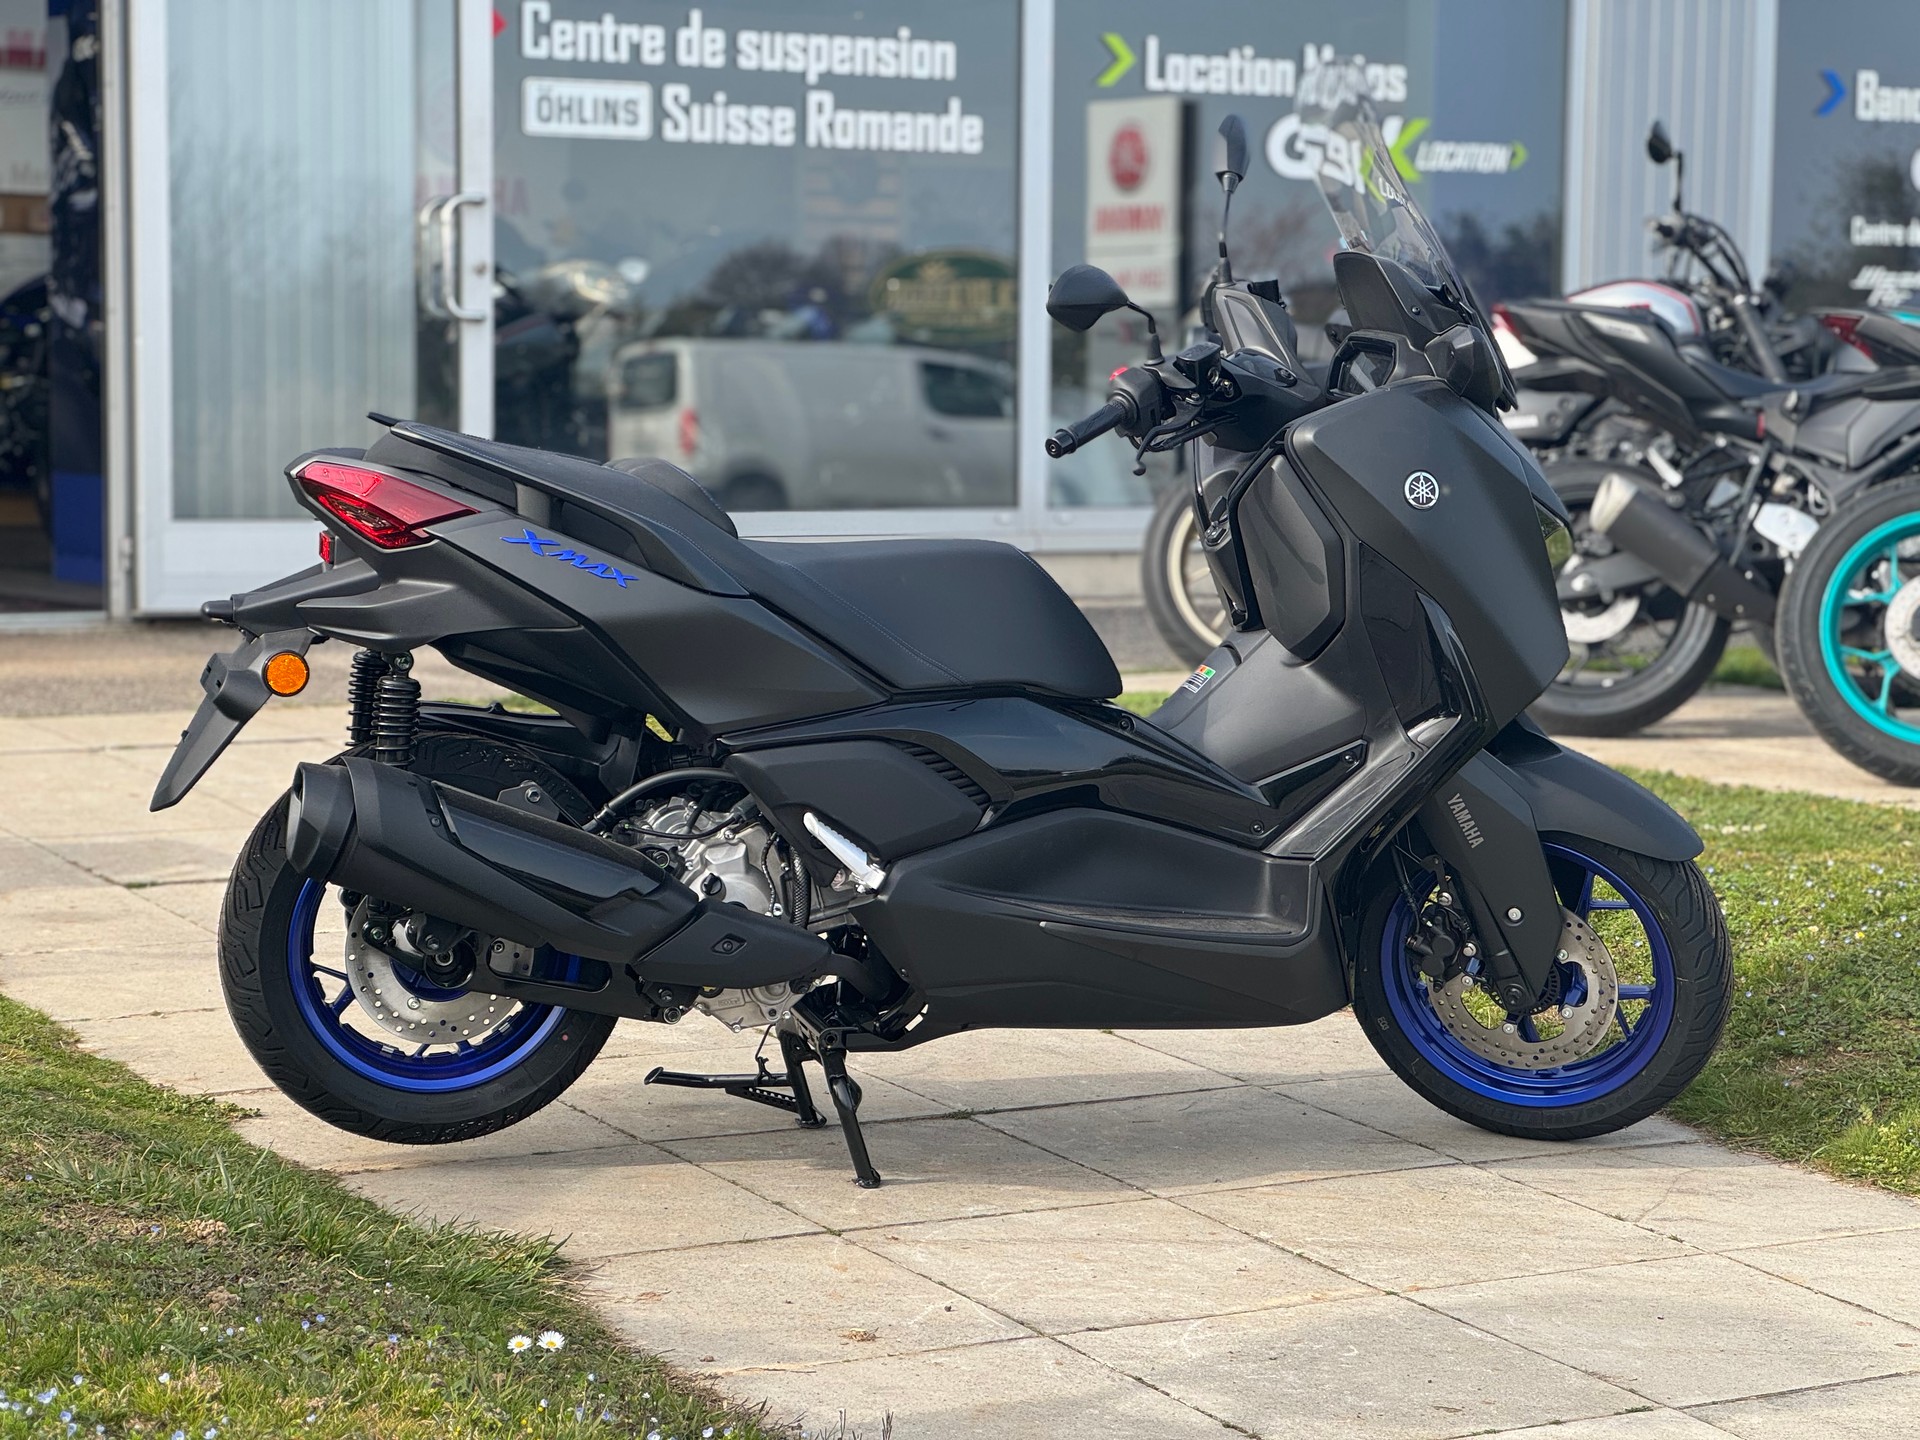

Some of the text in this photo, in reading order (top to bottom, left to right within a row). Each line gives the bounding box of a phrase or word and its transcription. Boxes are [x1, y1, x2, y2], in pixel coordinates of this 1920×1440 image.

[521, 0, 957, 86] Centre de suspension
[1145, 35, 1296, 97] Location
[536, 83, 641, 127] ÖHLINS
[661, 83, 984, 154] Suisse Romande
[1415, 141, 1511, 174] LOCATION
[499, 528, 640, 589] XMAX
[1447, 792, 1485, 849] YAMAHA
